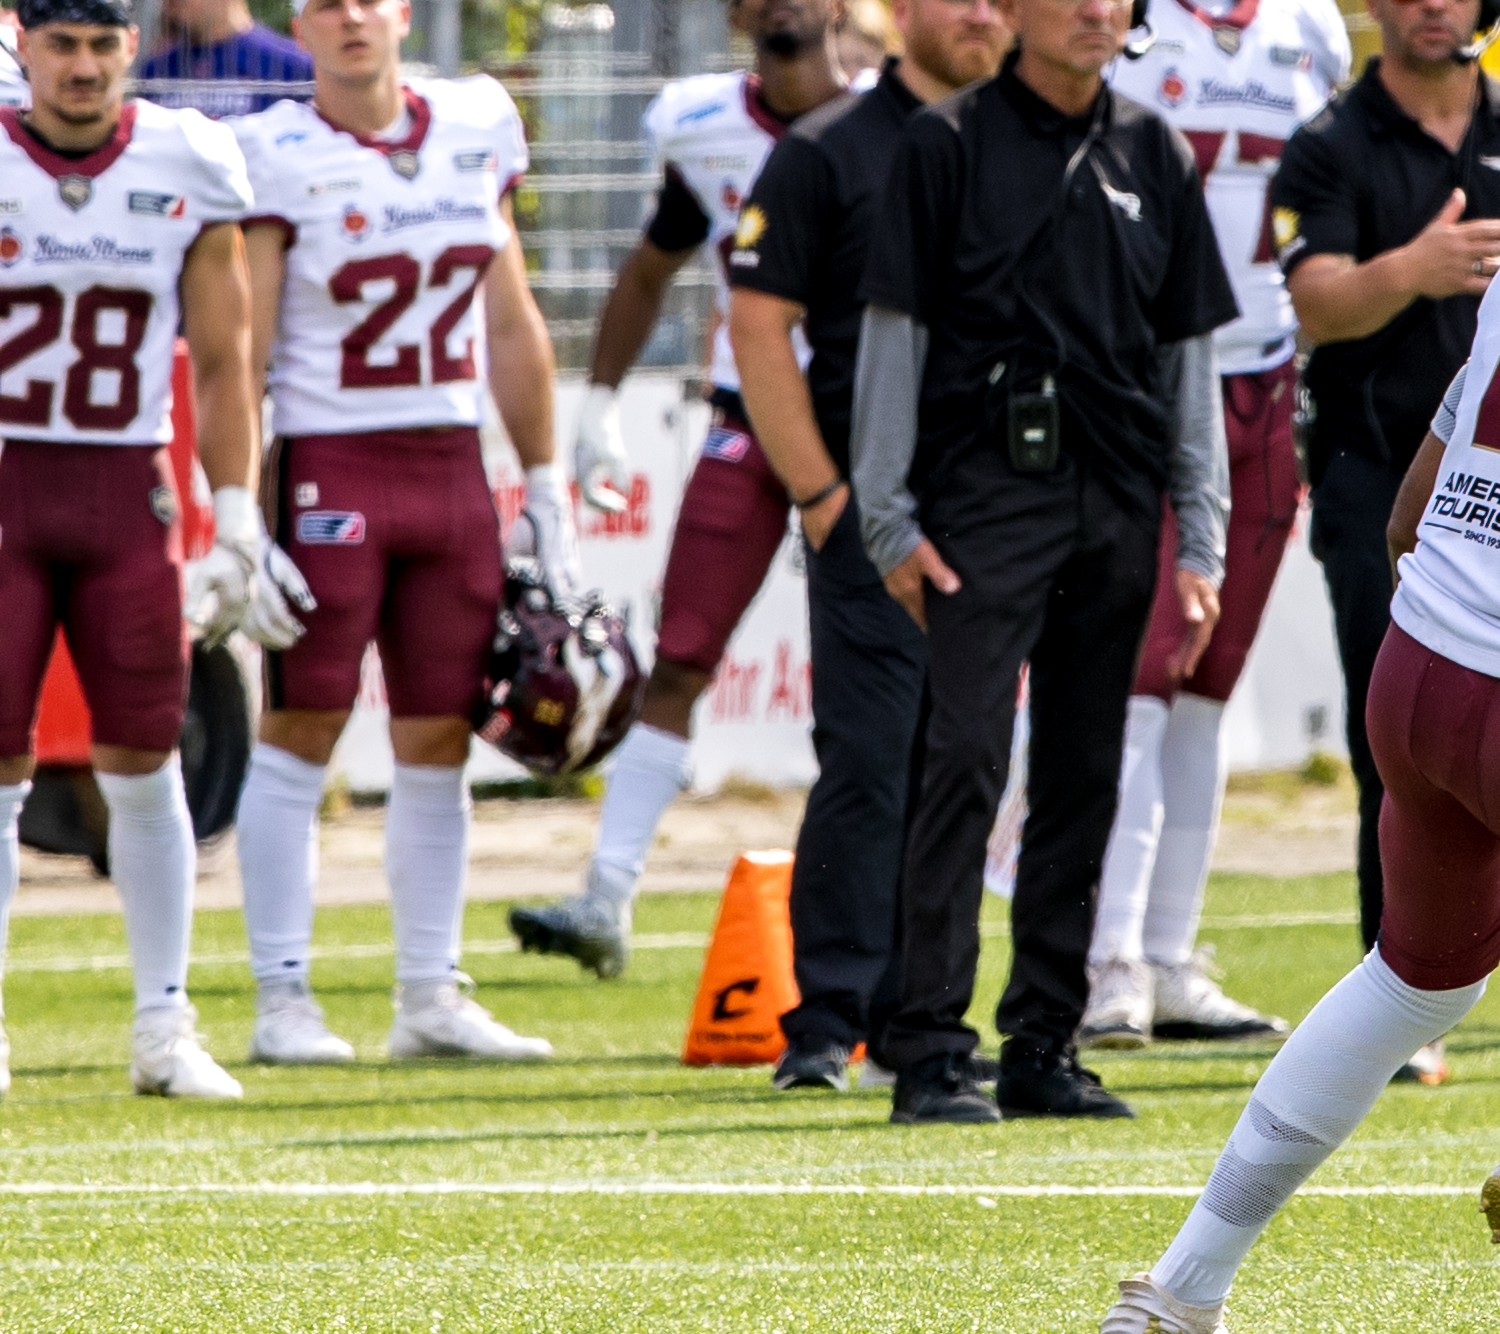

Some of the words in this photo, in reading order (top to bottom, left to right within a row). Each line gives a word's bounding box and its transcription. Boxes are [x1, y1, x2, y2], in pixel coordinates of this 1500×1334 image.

[0, 282, 155, 432] 28
[327, 243, 497, 390] 22
[1464, 529, 1487, 545] SINCE
